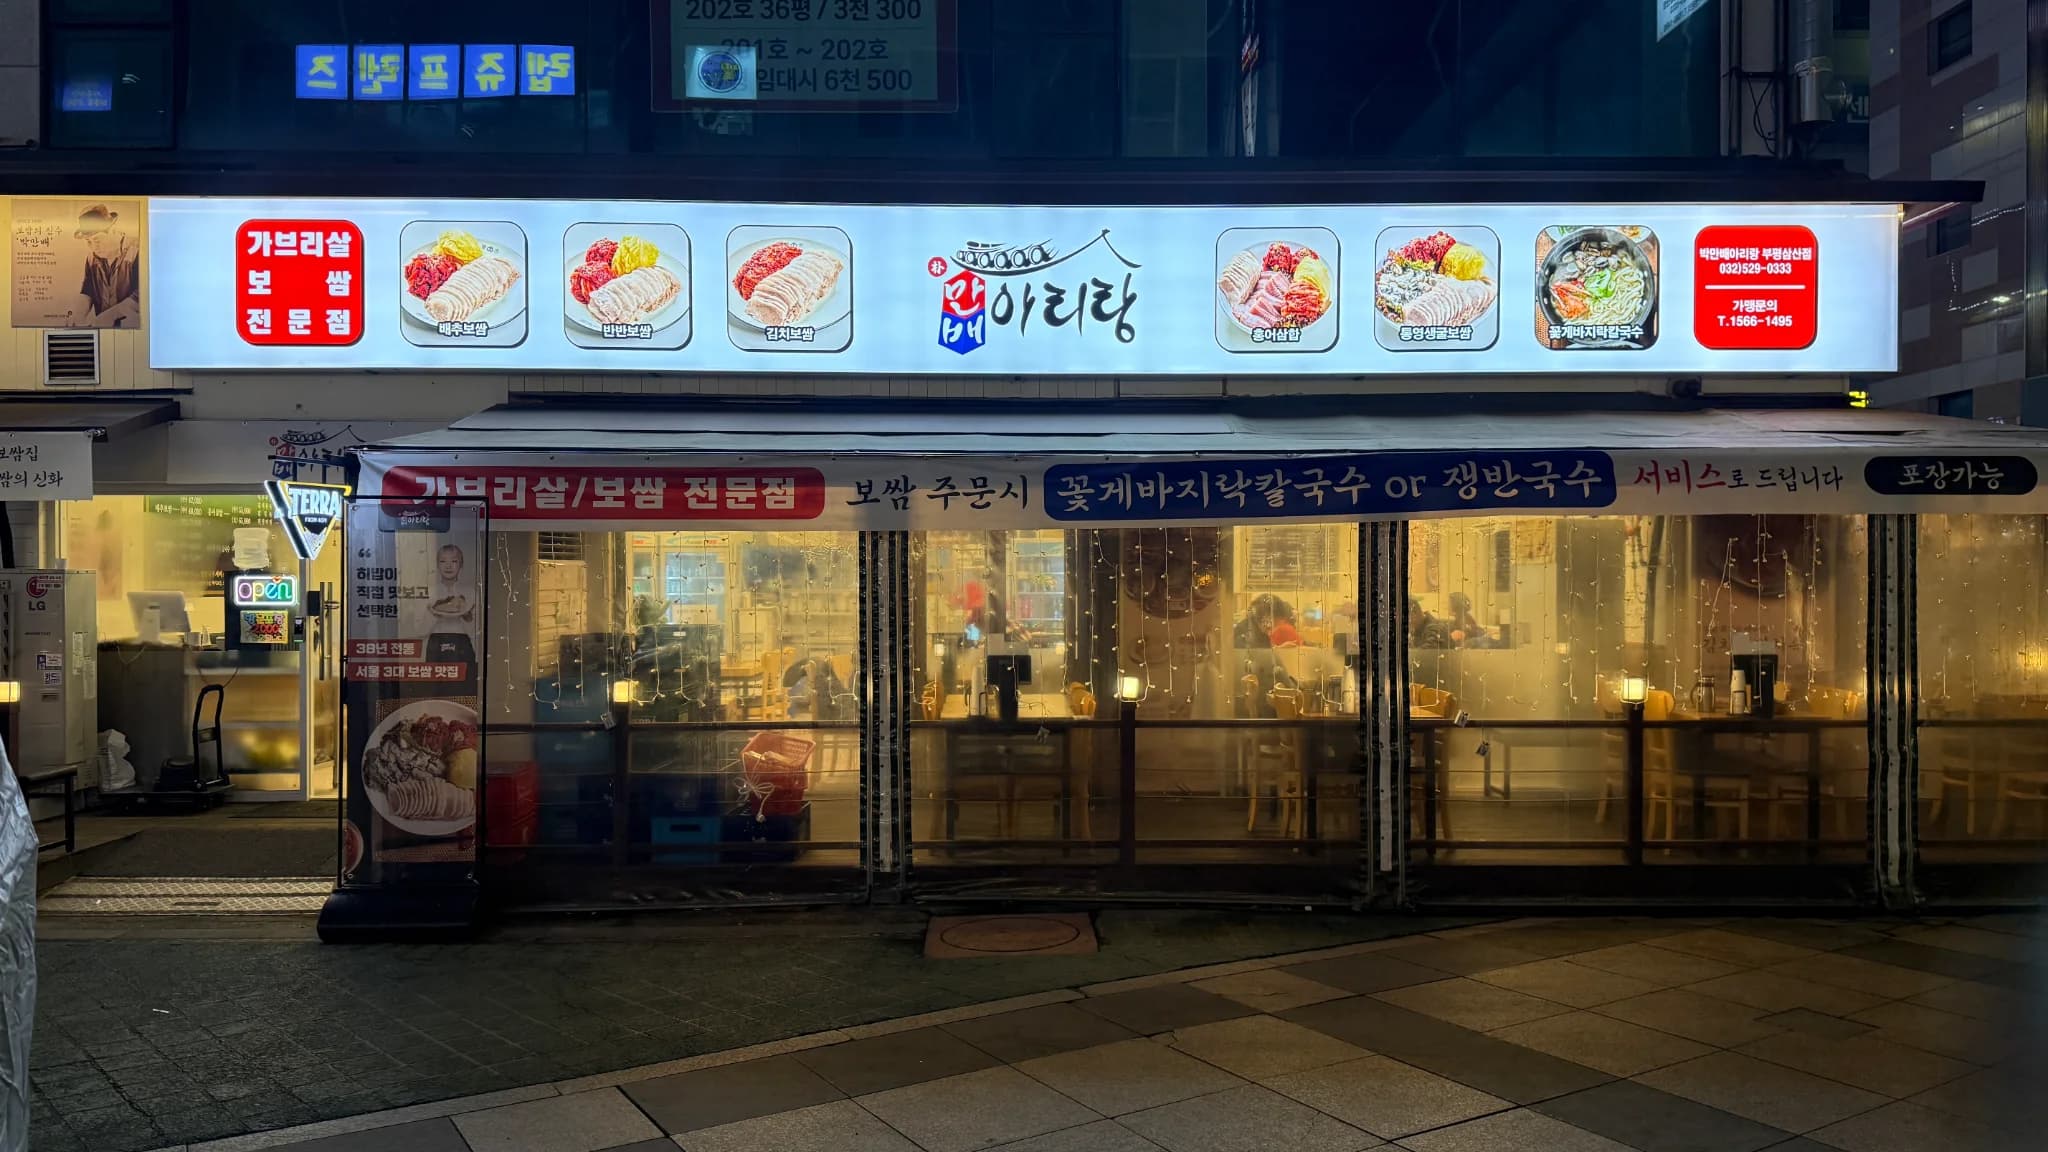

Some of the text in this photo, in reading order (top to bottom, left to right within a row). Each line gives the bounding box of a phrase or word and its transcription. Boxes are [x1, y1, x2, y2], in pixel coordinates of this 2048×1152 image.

[686, 0, 753, 20] 202호
[760, 0, 811, 21] 36평
[834, 0, 870, 20] 3천
[876, 0, 921, 20] 300
[821, 38, 888, 60] 202호
[825, 68, 860, 92] 6천
[867, 69, 912, 91] 500
[247, 231, 352, 258] 가브리살
[1762, 247, 1812, 260] 부평삼산점
[1719, 262, 1792, 275] 032)529-0333
[991, 272, 1137, 344] 아리랑
[1732, 299, 1778, 313] 가맹문의
[1717, 315, 1792, 327] T.1566-1495
[438, 321, 488, 337] 배추보쌈
[603, 324, 652, 339] 반반보쌈
[766, 327, 815, 342] 김치보쌈
[1252, 326, 1300, 342] 홍어삼합
[1400, 326, 1472, 341] 통영생굴보쌈
[1549, 325, 1644, 340] 꽃게바지락칼국수
[33, 470, 64, 488] 신화
[1897, 461, 2004, 490] 포장가능
[412, 459, 1844, 512] 가브리살/보쌈 전문점 보쌈 주문시 꽃게바지락칼국수 or 쟁반국수 서비스로 드립니다
[288, 488, 341, 517] TERRA
[356, 567, 397, 581] 히밥이
[238, 582, 293, 603] open
[356, 586, 430, 600] 직접 맛보고
[28, 601, 46, 611] LG
[356, 604, 398, 618] 선택한
[356, 642, 415, 655] 38년 전통
[356, 666, 459, 679] 서울 3대 보쌈 맛집
